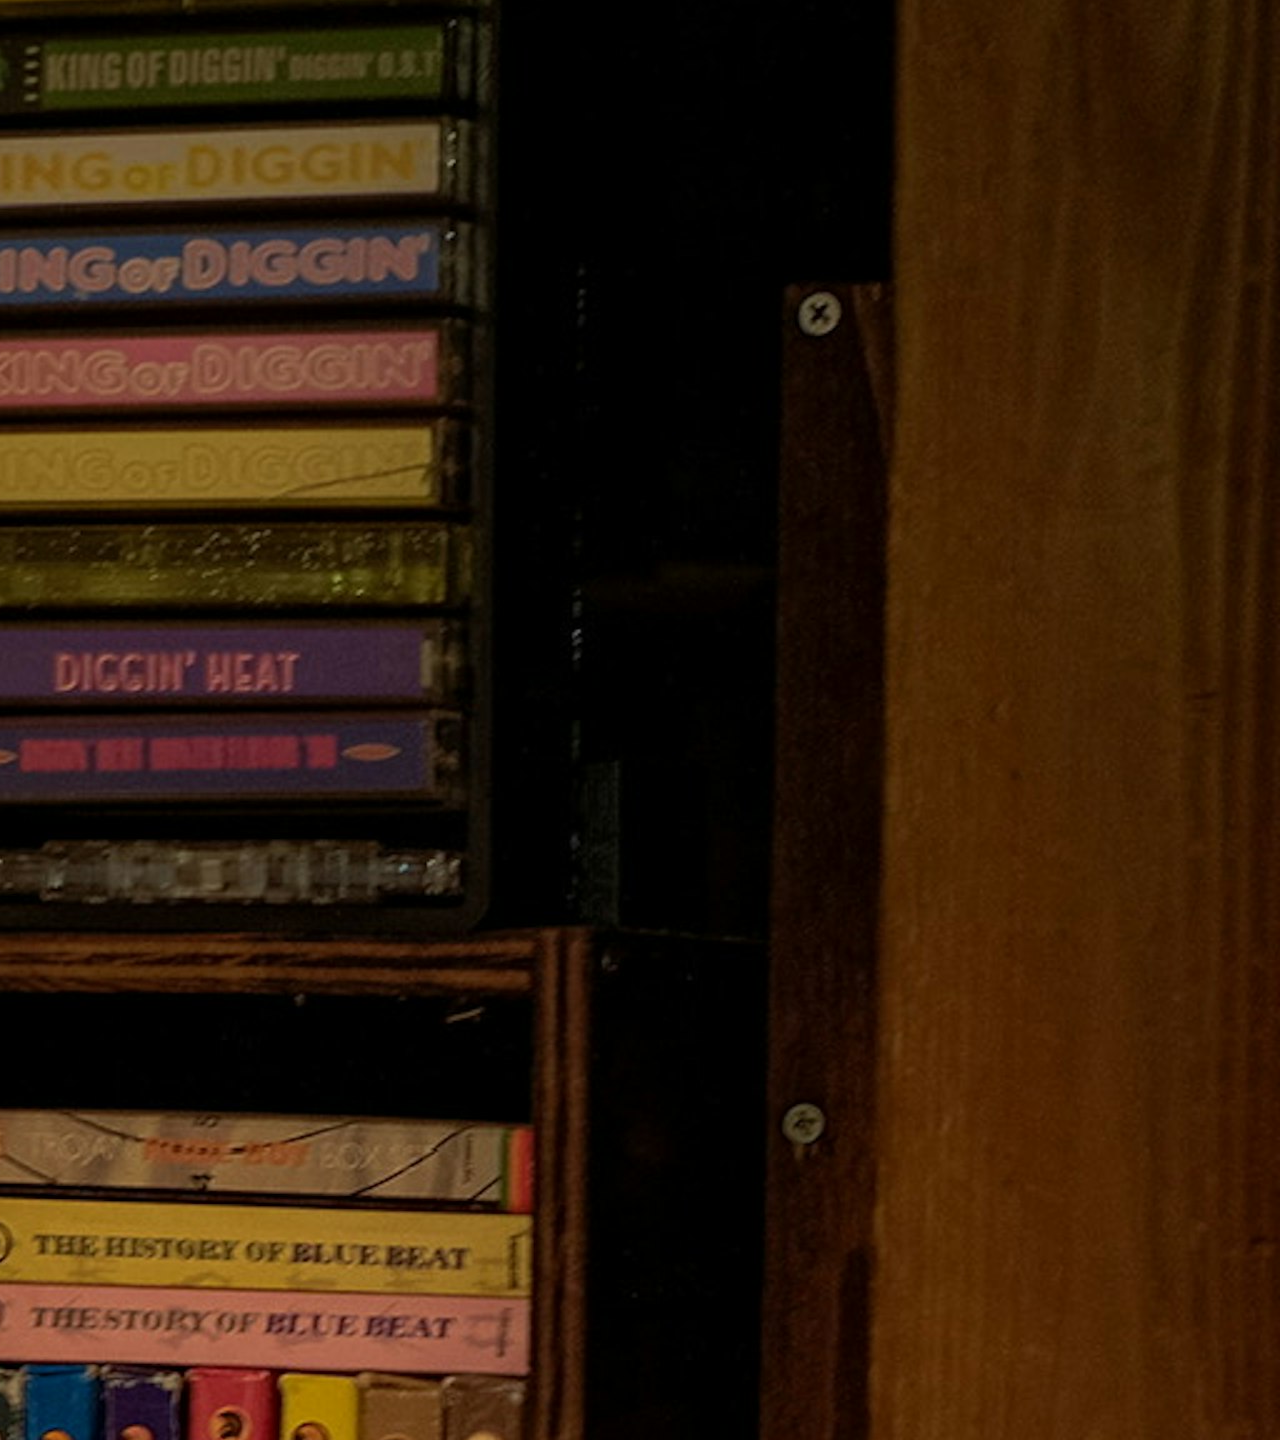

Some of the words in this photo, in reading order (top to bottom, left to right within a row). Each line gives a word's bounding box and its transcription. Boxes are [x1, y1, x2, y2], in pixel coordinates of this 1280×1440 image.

[46, 53, 124, 90] KING
[125, 52, 163, 88] OF
[169, 46, 288, 87] DIGGIN'
[53, 651, 198, 693] DIGGIN'
[203, 653, 301, 693] HEAT
[32, 1233, 99, 1259] THE
[106, 1236, 239, 1264] HISTORY
[245, 1241, 288, 1264] OF
[290, 1241, 379, 1268] BLUE
[384, 1244, 471, 1271] BEAT
[30, 1306, 100, 1331] THE
[100, 1307, 216, 1333] STORY
[221, 1310, 259, 1333] OF
[264, 1312, 355, 1337] BLUE
[363, 1314, 458, 1340] BEAT
